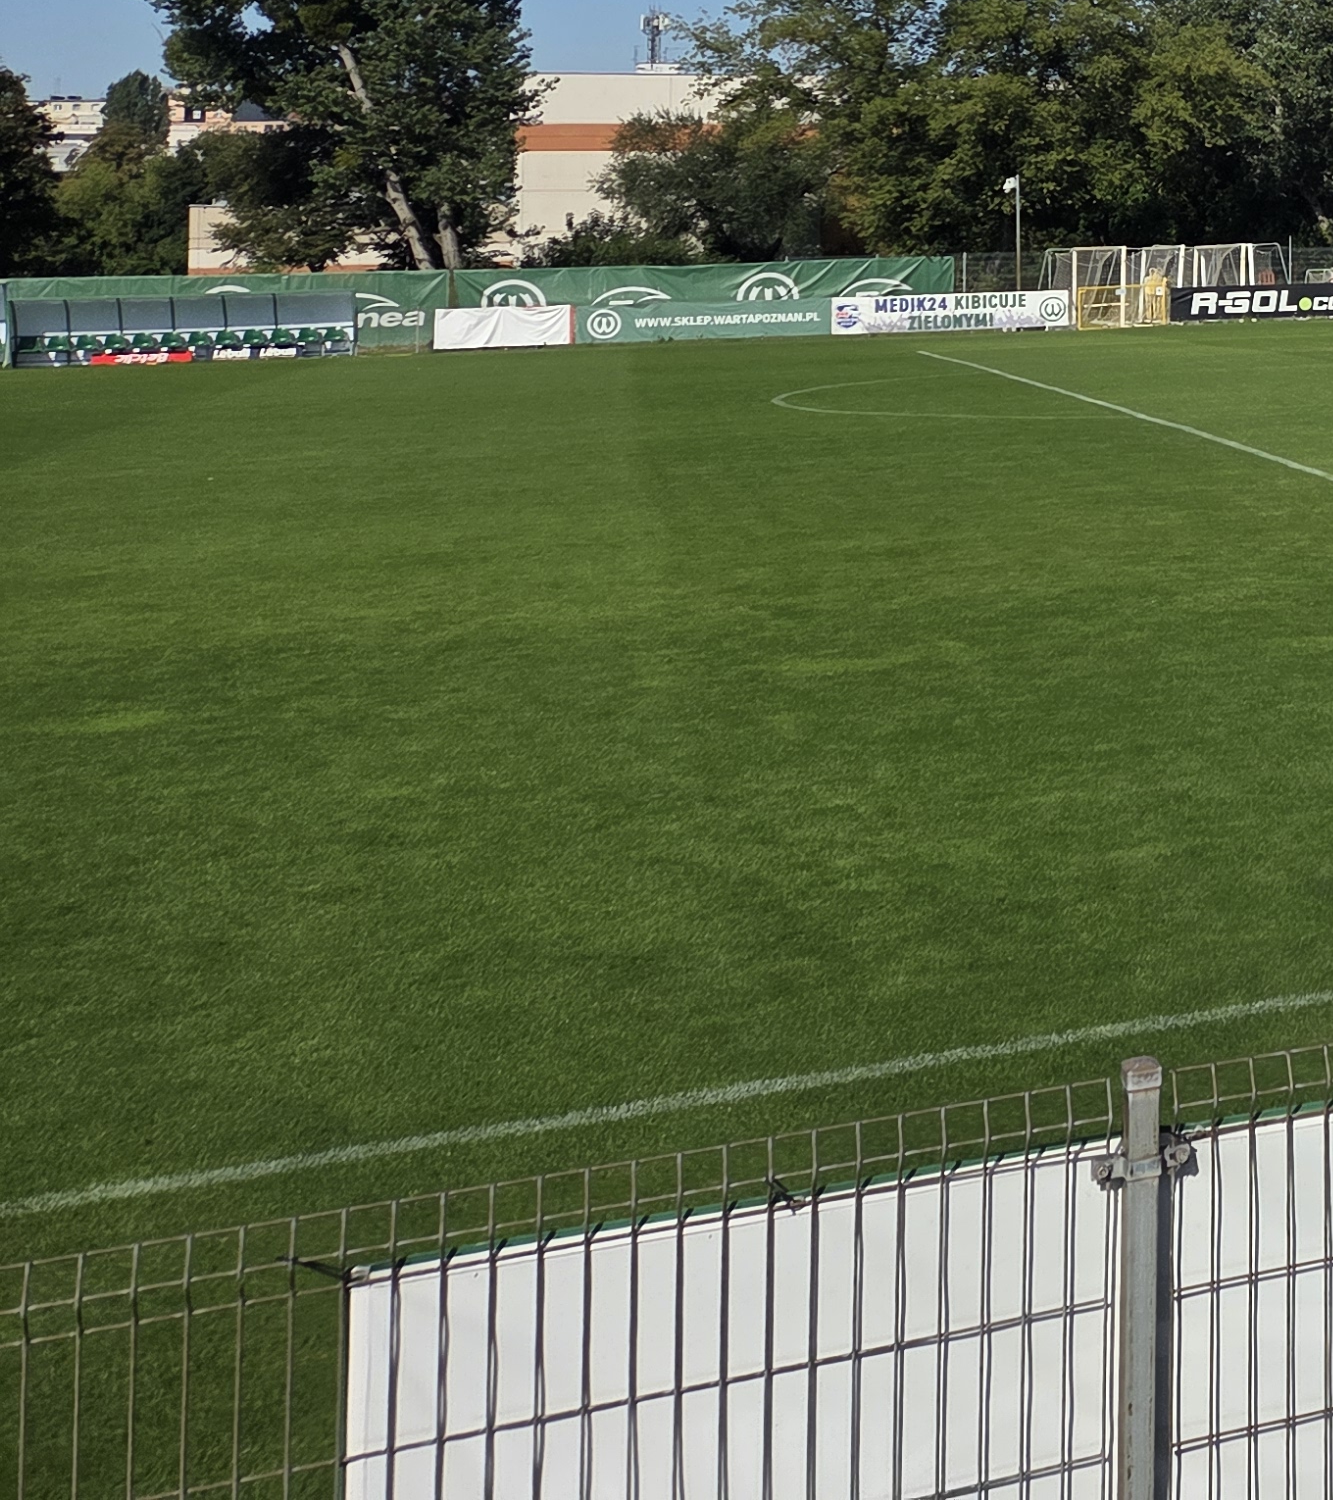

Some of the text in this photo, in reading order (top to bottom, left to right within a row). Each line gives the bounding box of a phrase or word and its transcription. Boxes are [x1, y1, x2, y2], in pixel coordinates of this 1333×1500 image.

[874, 293, 1027, 313] MEDIK24 KIBICUJE
[357, 310, 426, 329] nea
[634, 311, 821, 329] WWW.SKLEP.WARTAPOZNAN.PL
[907, 312, 994, 331] ZIELONYM!
